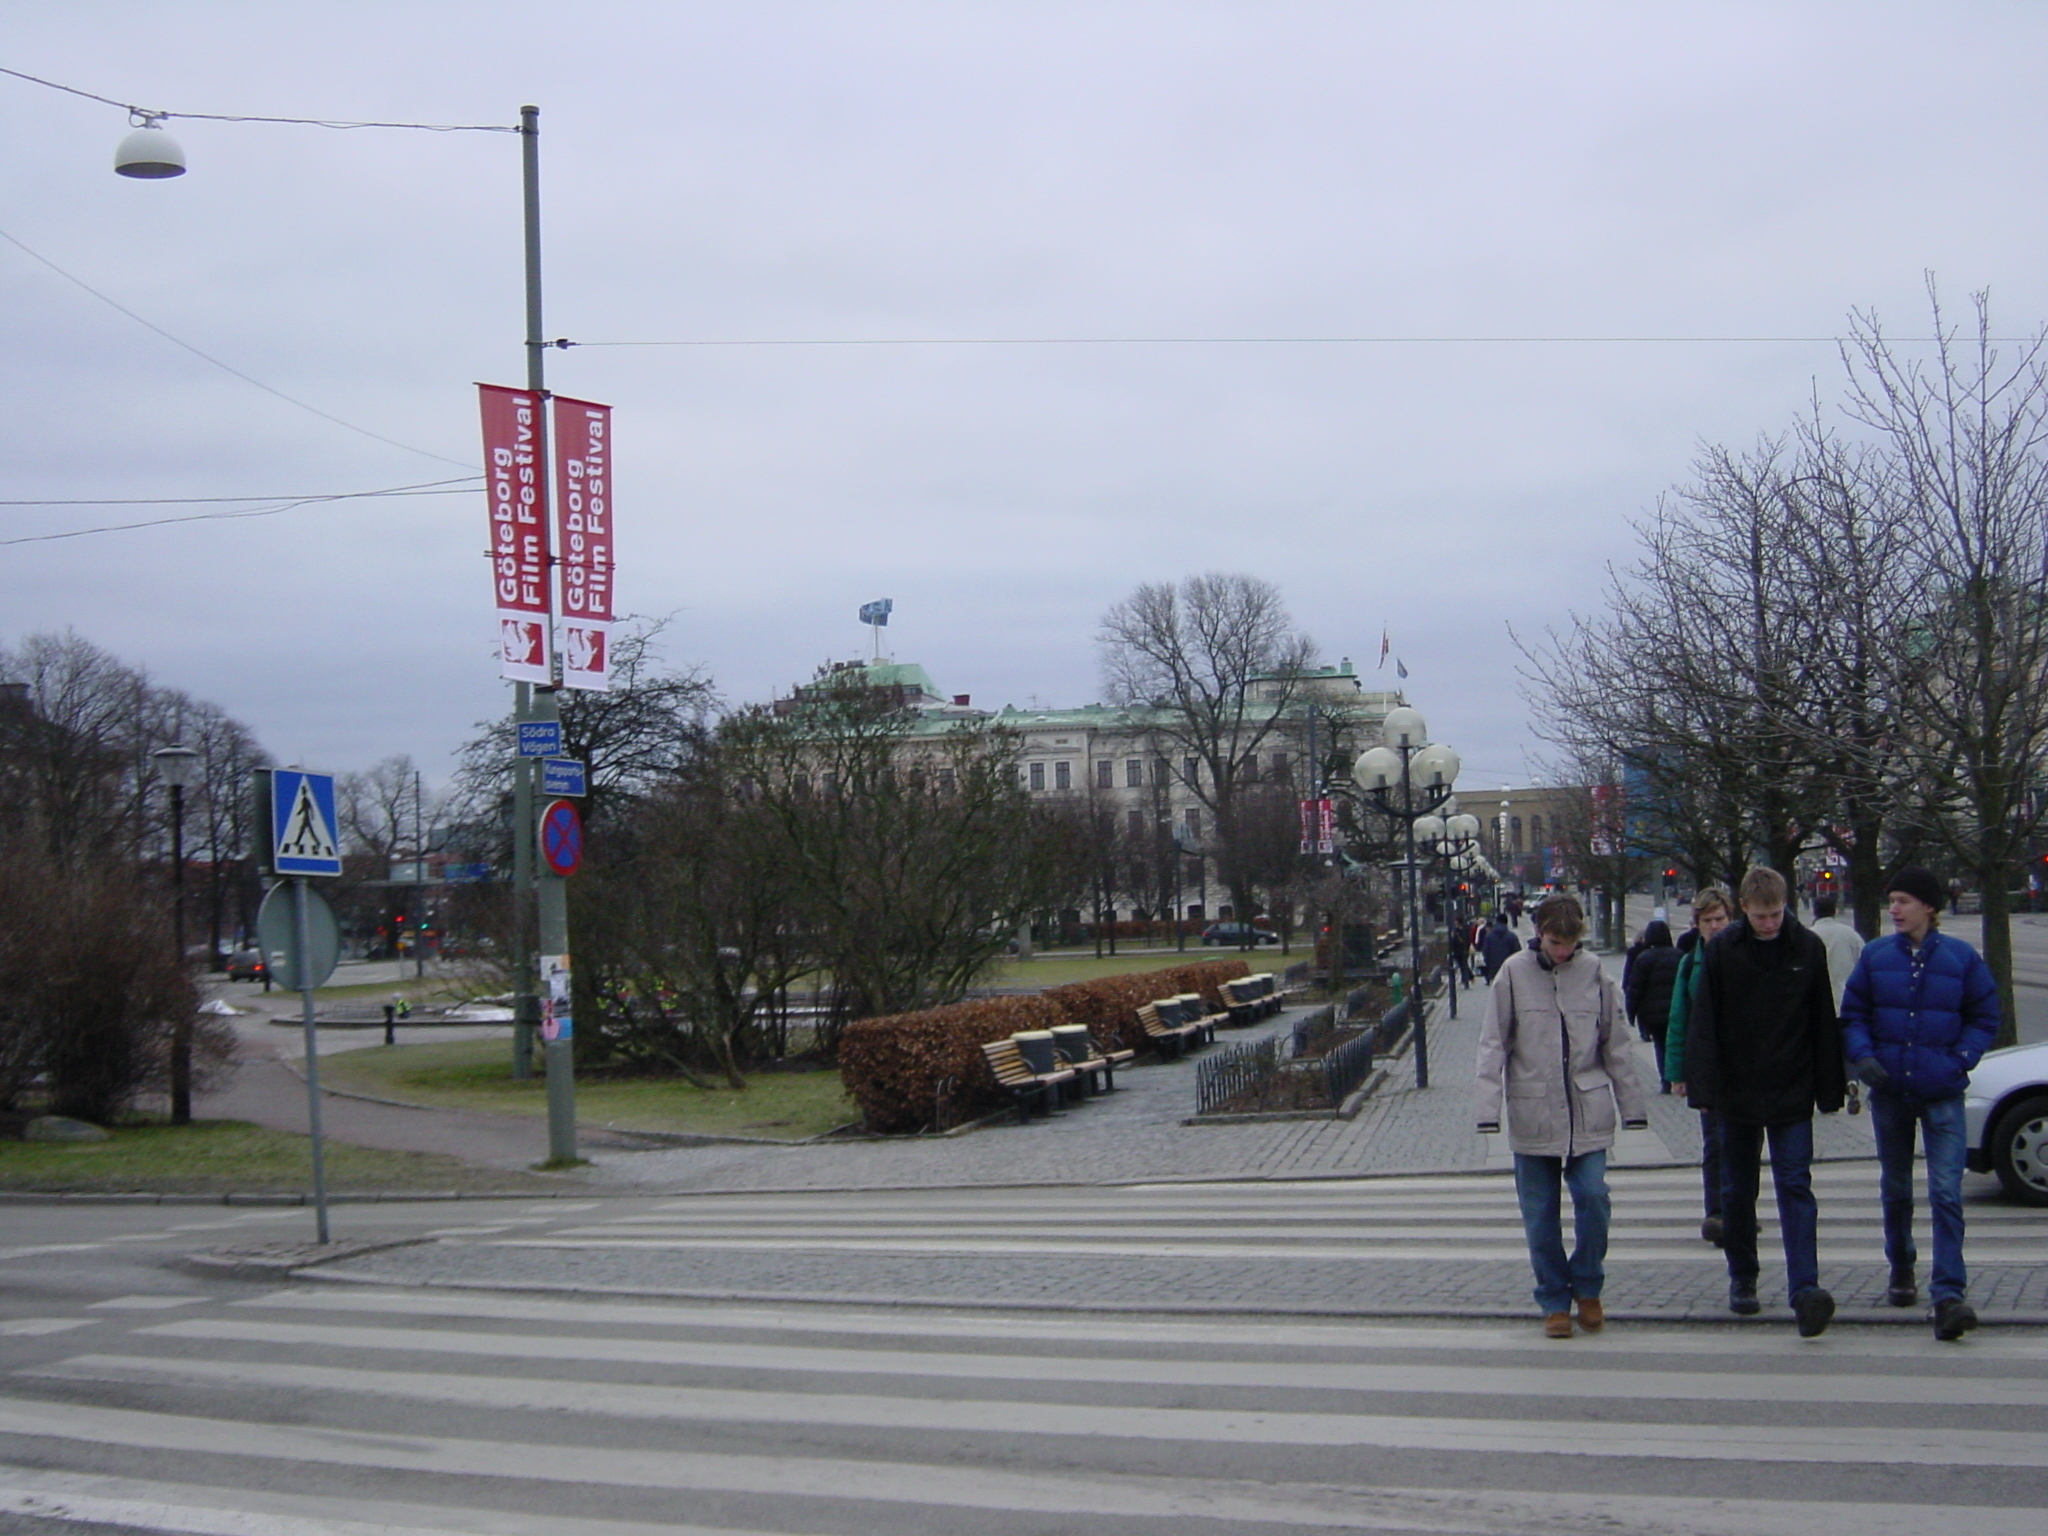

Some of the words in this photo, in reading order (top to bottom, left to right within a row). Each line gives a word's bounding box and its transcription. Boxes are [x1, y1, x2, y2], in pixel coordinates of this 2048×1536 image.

[512, 397, 538, 526] Festival
[586, 410, 605, 535] Festival
[494, 448, 518, 603] Göteborg
[522, 536, 542, 606] Film
[567, 459, 585, 612] Göteborg
[588, 544, 606, 614] Film
[521, 726, 555, 738] Södra
